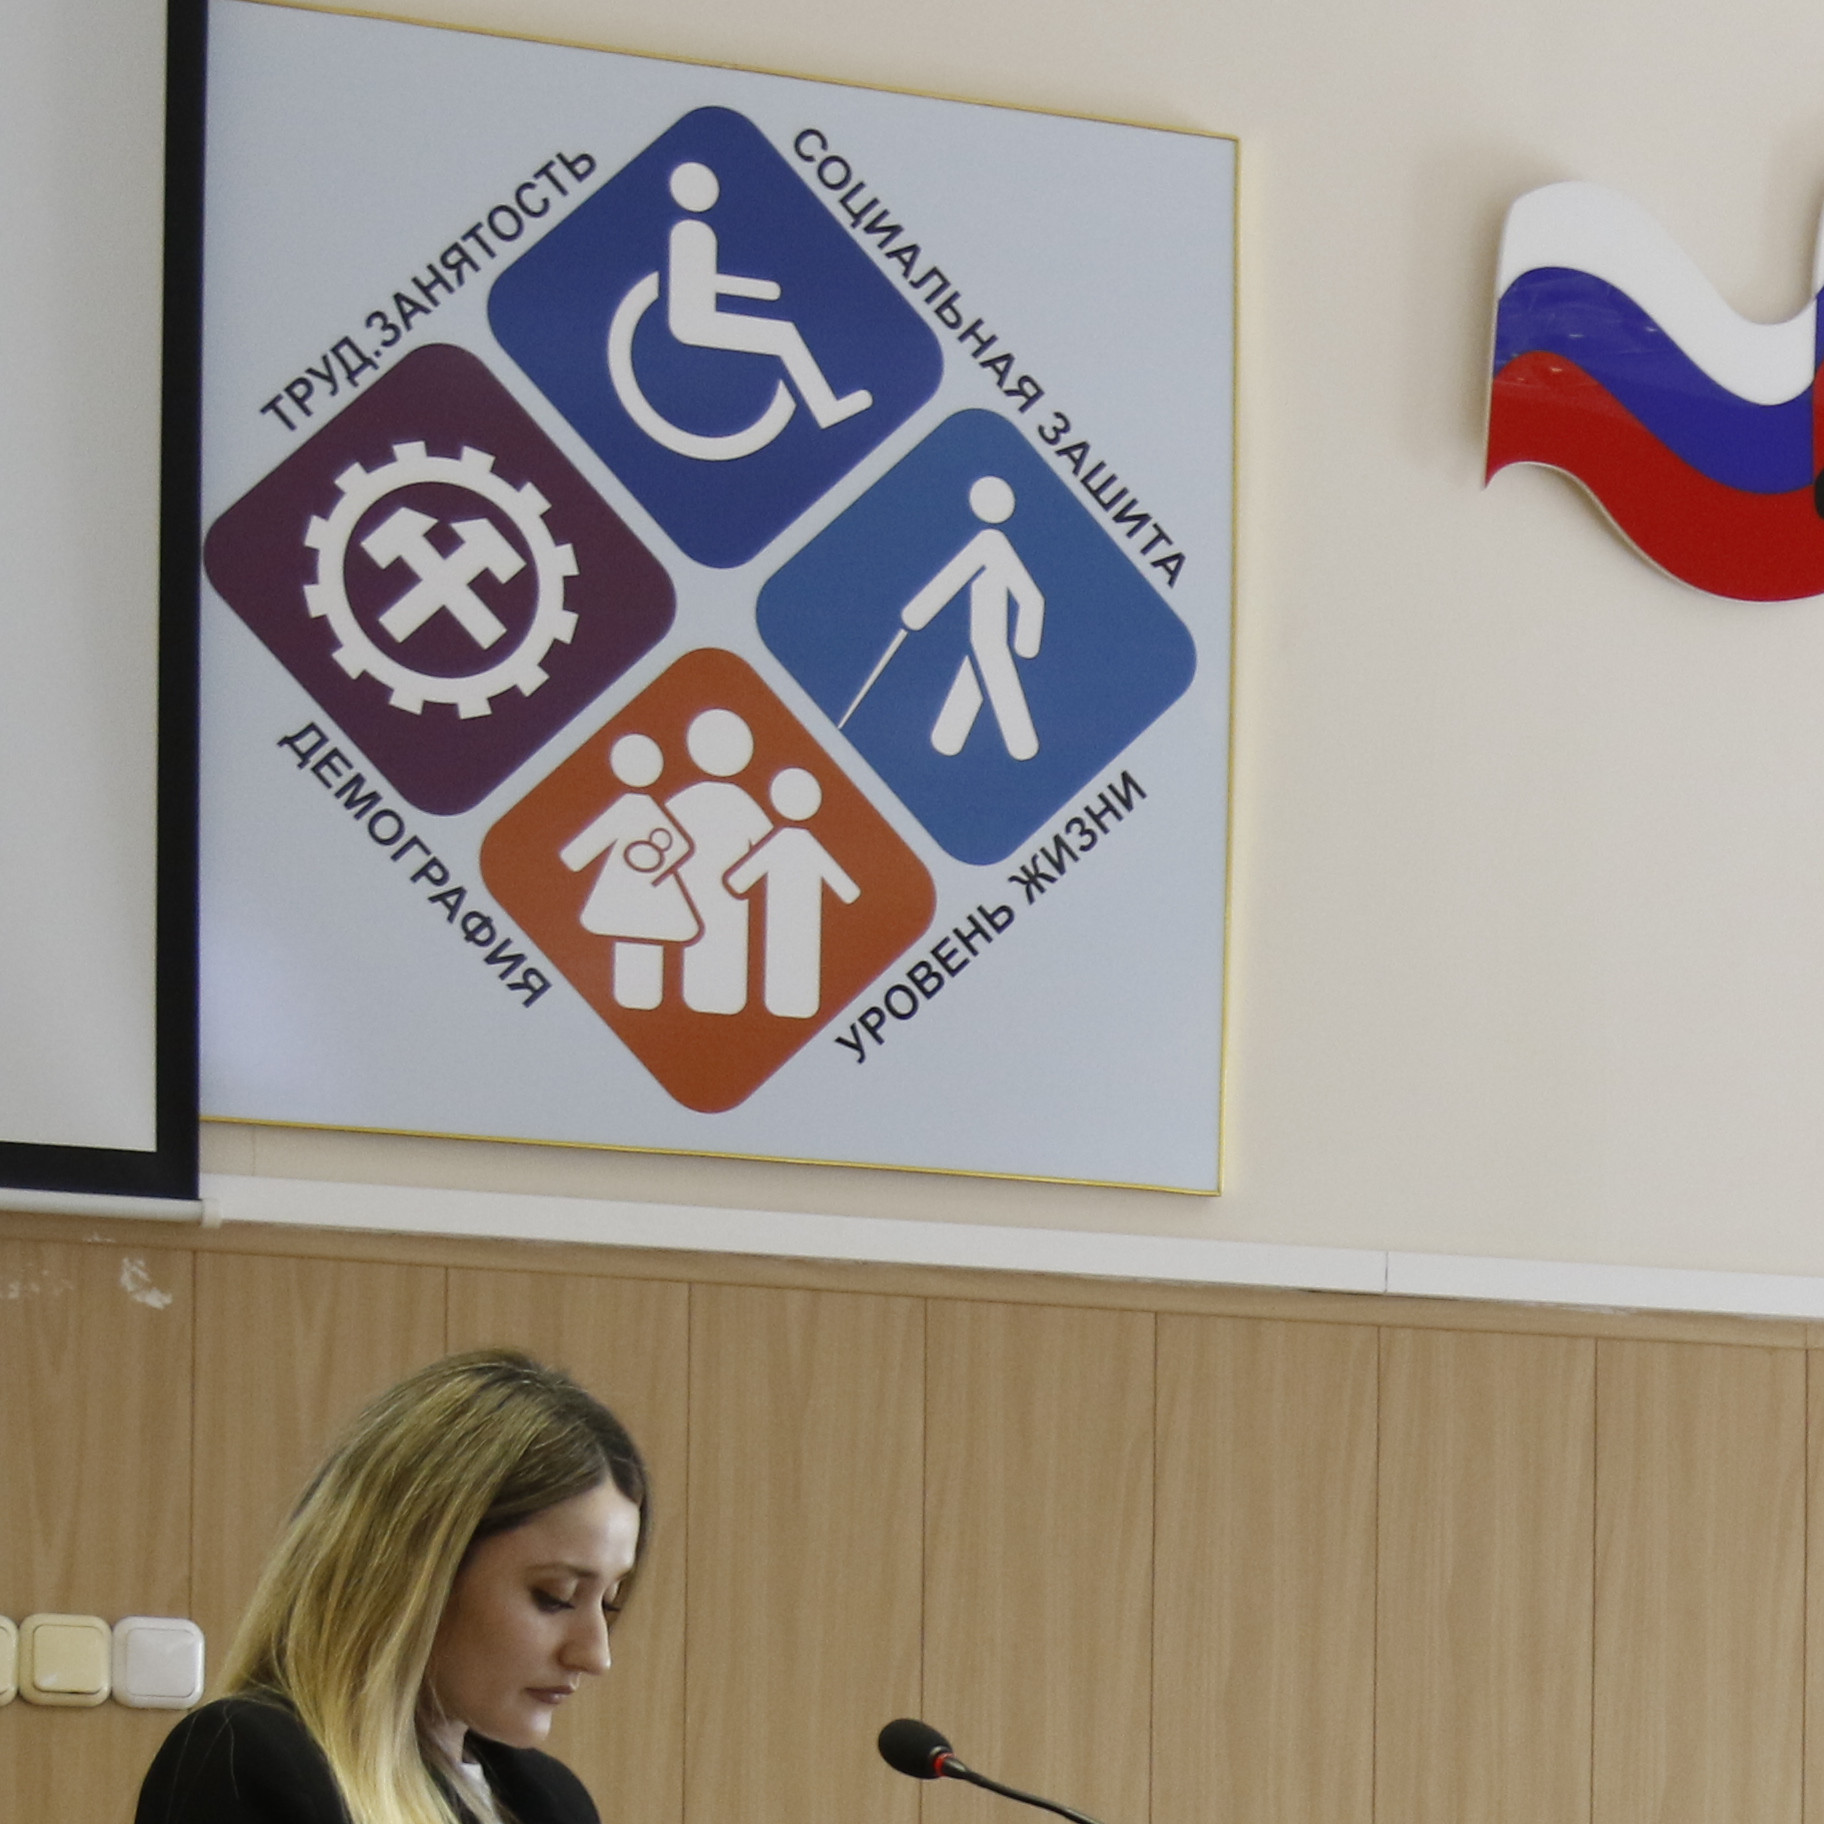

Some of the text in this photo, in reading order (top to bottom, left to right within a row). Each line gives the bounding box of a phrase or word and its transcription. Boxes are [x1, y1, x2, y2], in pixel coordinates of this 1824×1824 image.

[259, 143, 600, 437] ТРУД.ЗАНЯТОСТЬ
[792, 126, 1046, 415] СОЦИАЛЬНАЯ
[276, 719, 554, 1008] ДЕМОГРАФИЯ
[833, 769, 1148, 1065] УРОВЕНЬ ЖИЗНИ
